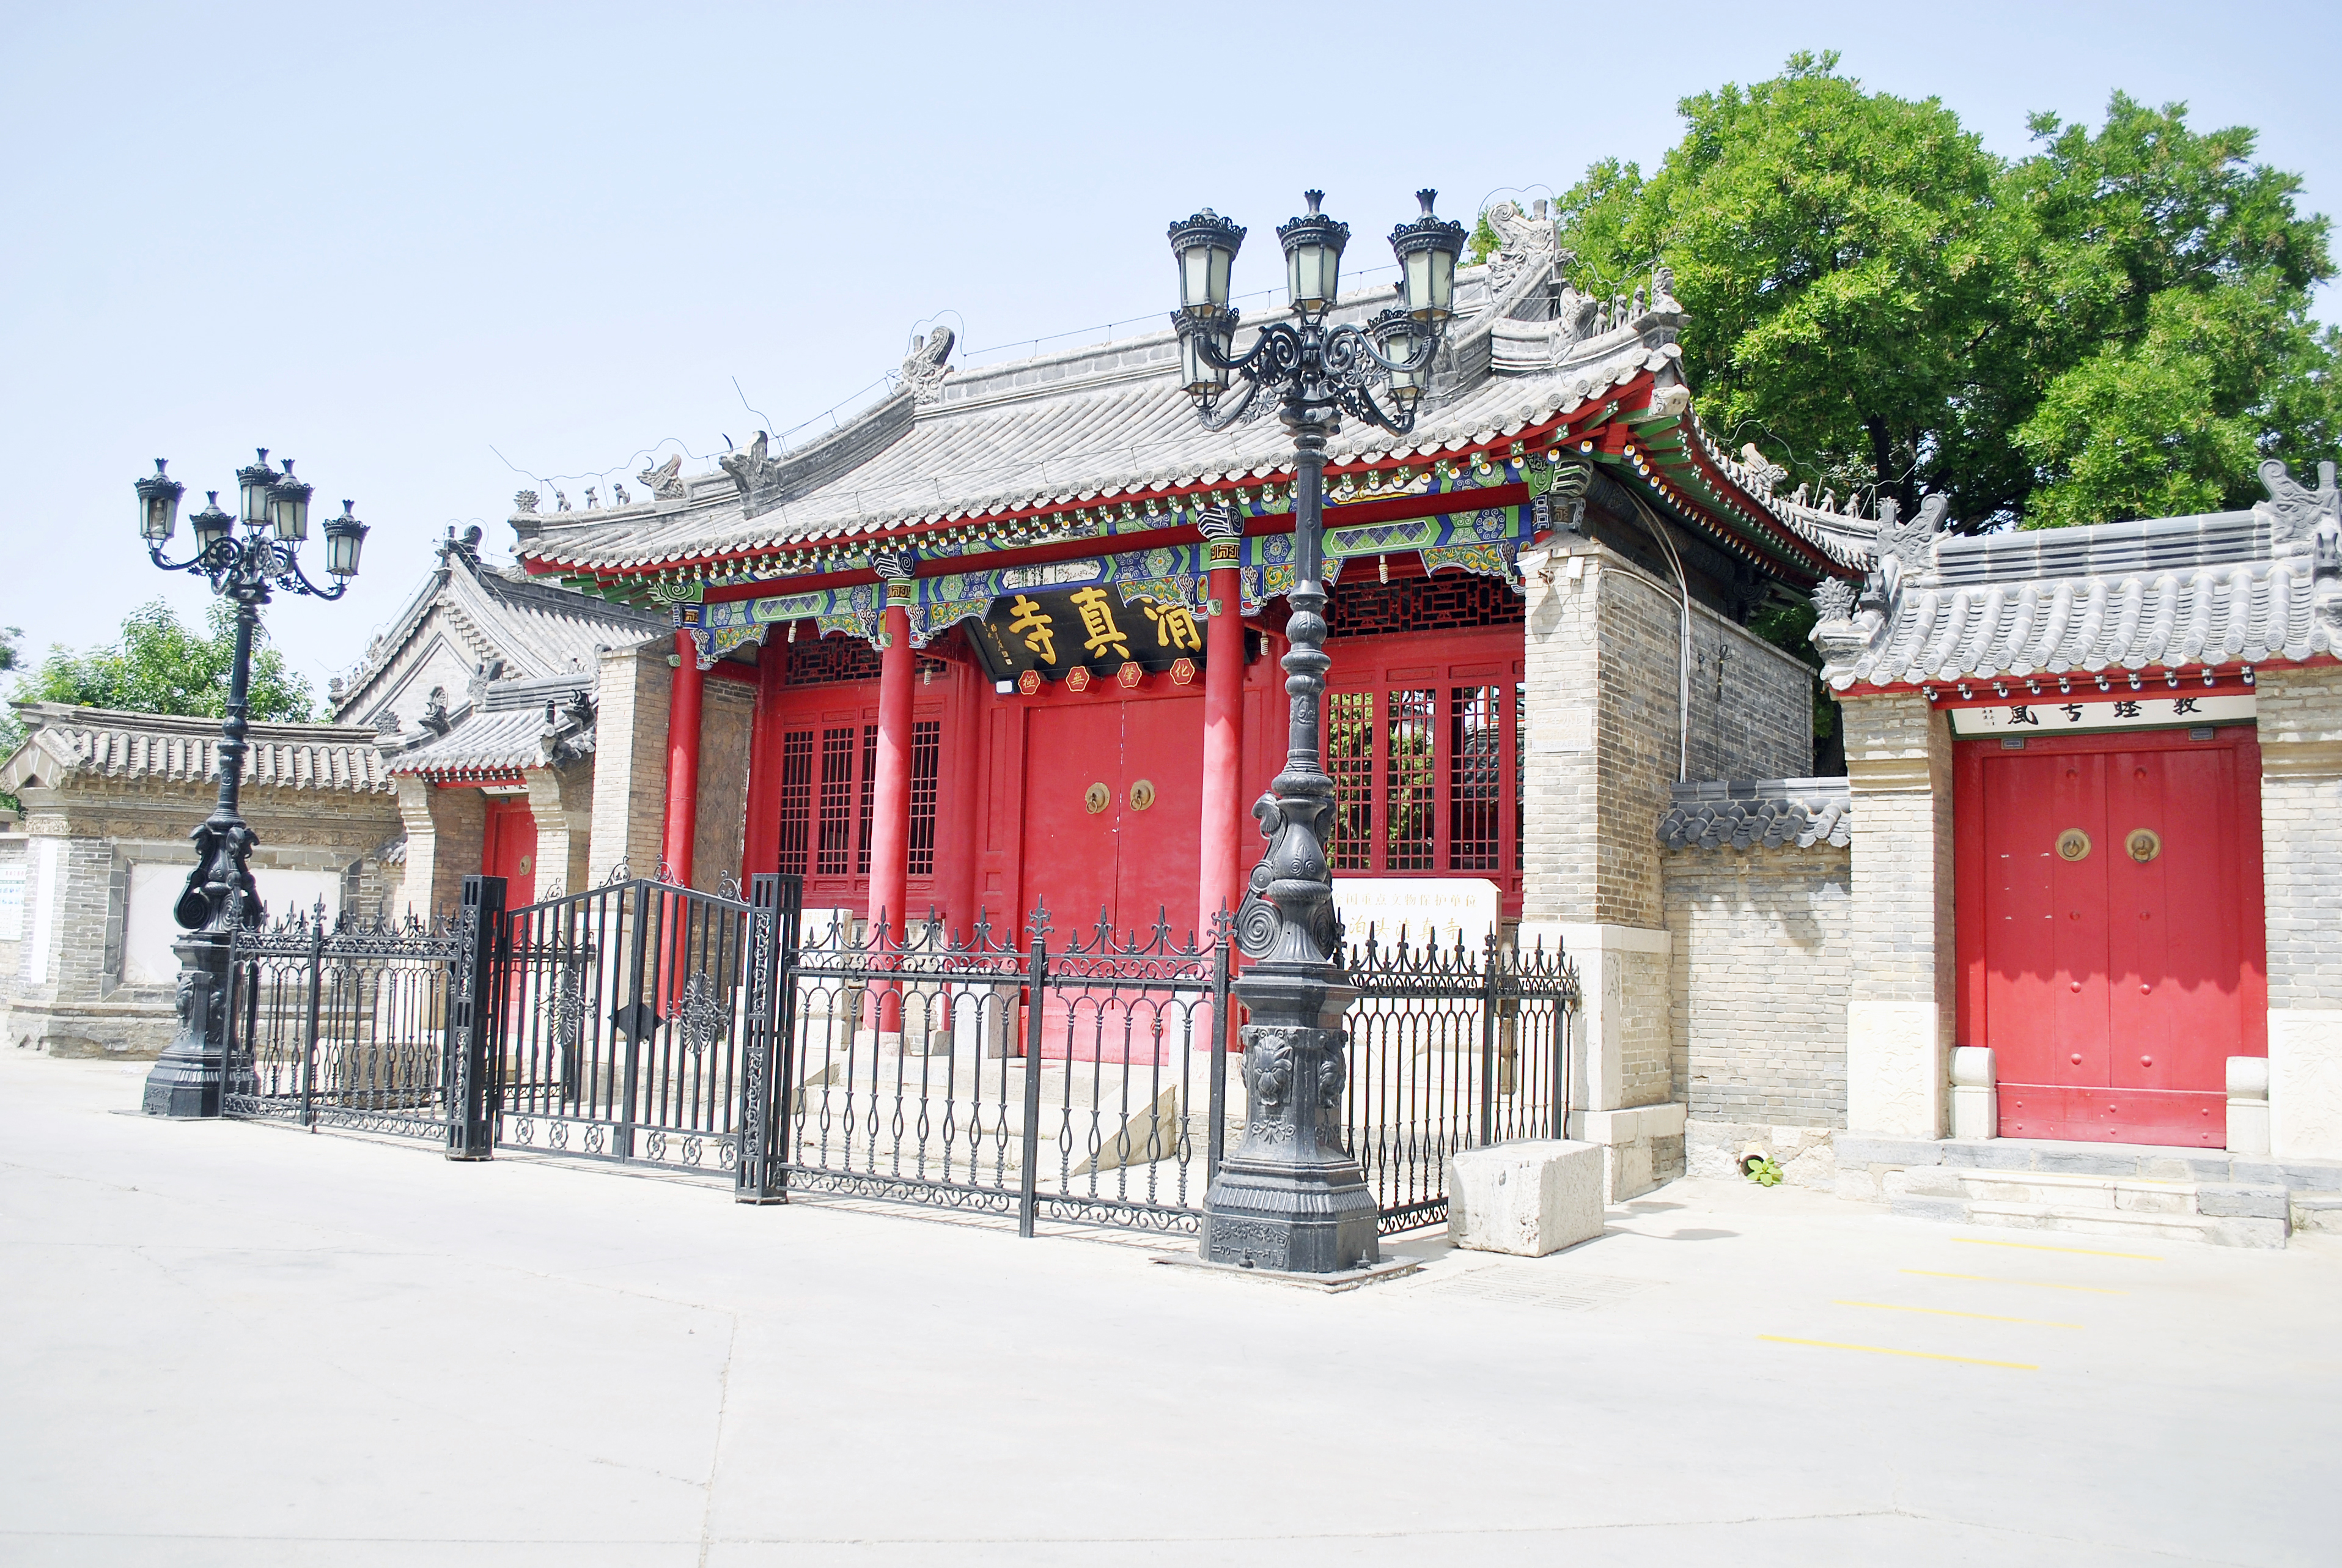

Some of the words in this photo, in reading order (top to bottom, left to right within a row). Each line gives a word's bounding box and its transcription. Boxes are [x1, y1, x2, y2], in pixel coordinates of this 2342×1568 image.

[1009, 587, 1201, 665] 清真寺
[1537, 713, 1586, 728] 安全小区
[1542, 740, 1587, 748] 泊头市人民政府
[1333, 893, 1477, 907] 全国重点文物保护单位
[1349, 915, 1463, 939] 泊头清真寺
